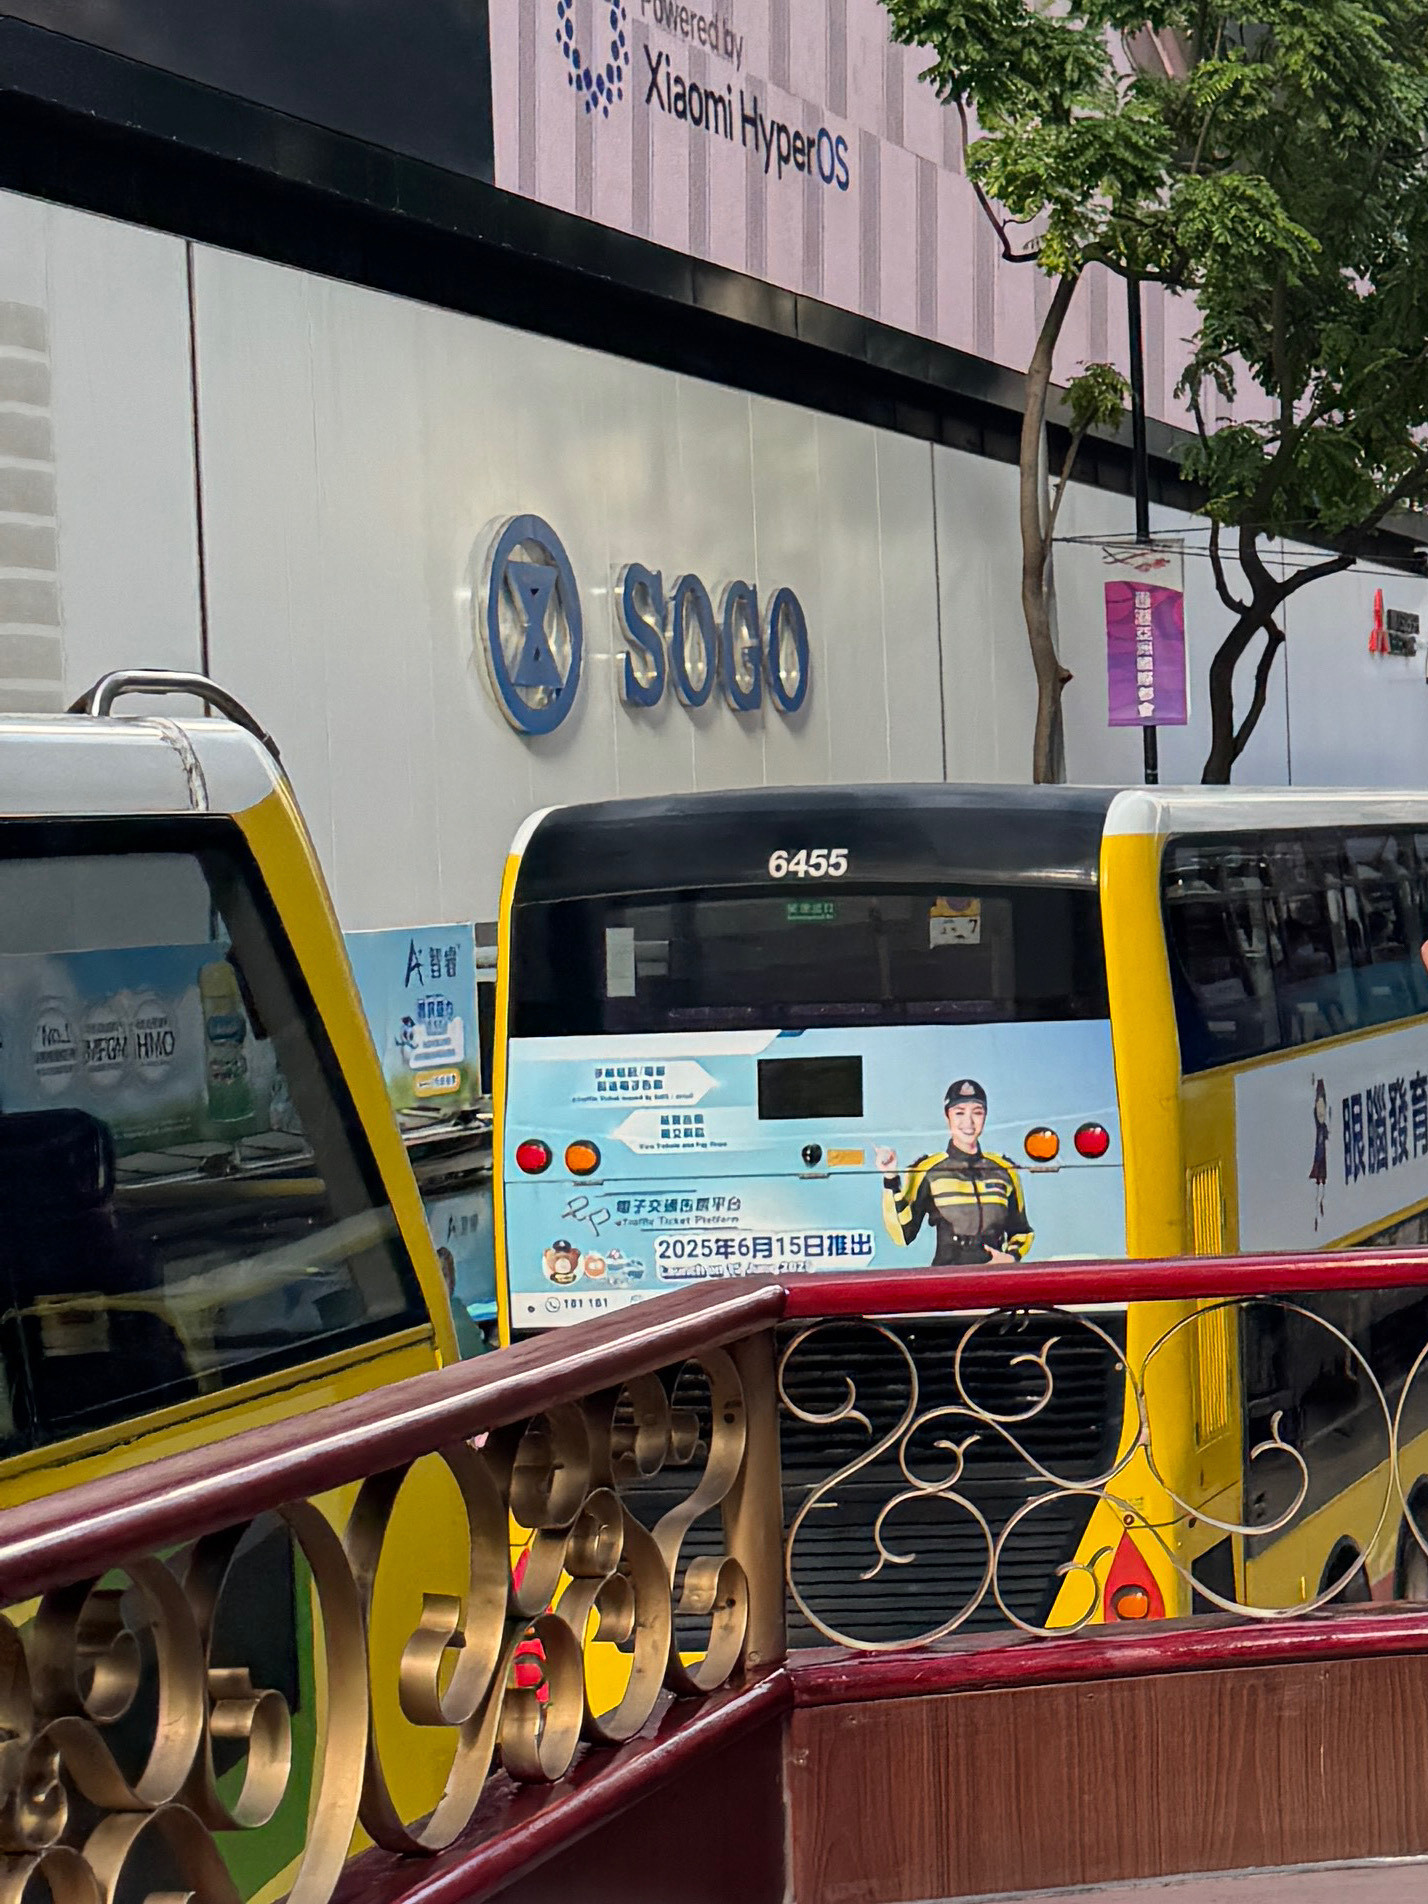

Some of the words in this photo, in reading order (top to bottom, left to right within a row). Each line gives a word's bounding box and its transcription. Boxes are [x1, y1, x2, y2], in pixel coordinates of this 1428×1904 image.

[722, 11, 744, 72] by
[644, 44, 733, 142] Xiaomi
[740, 88, 850, 192] HyperOS
[614, 562, 810, 713] SOGO
[768, 848, 849, 878] 6455
[658, 1232, 874, 1259] 2025年6月15日推出
